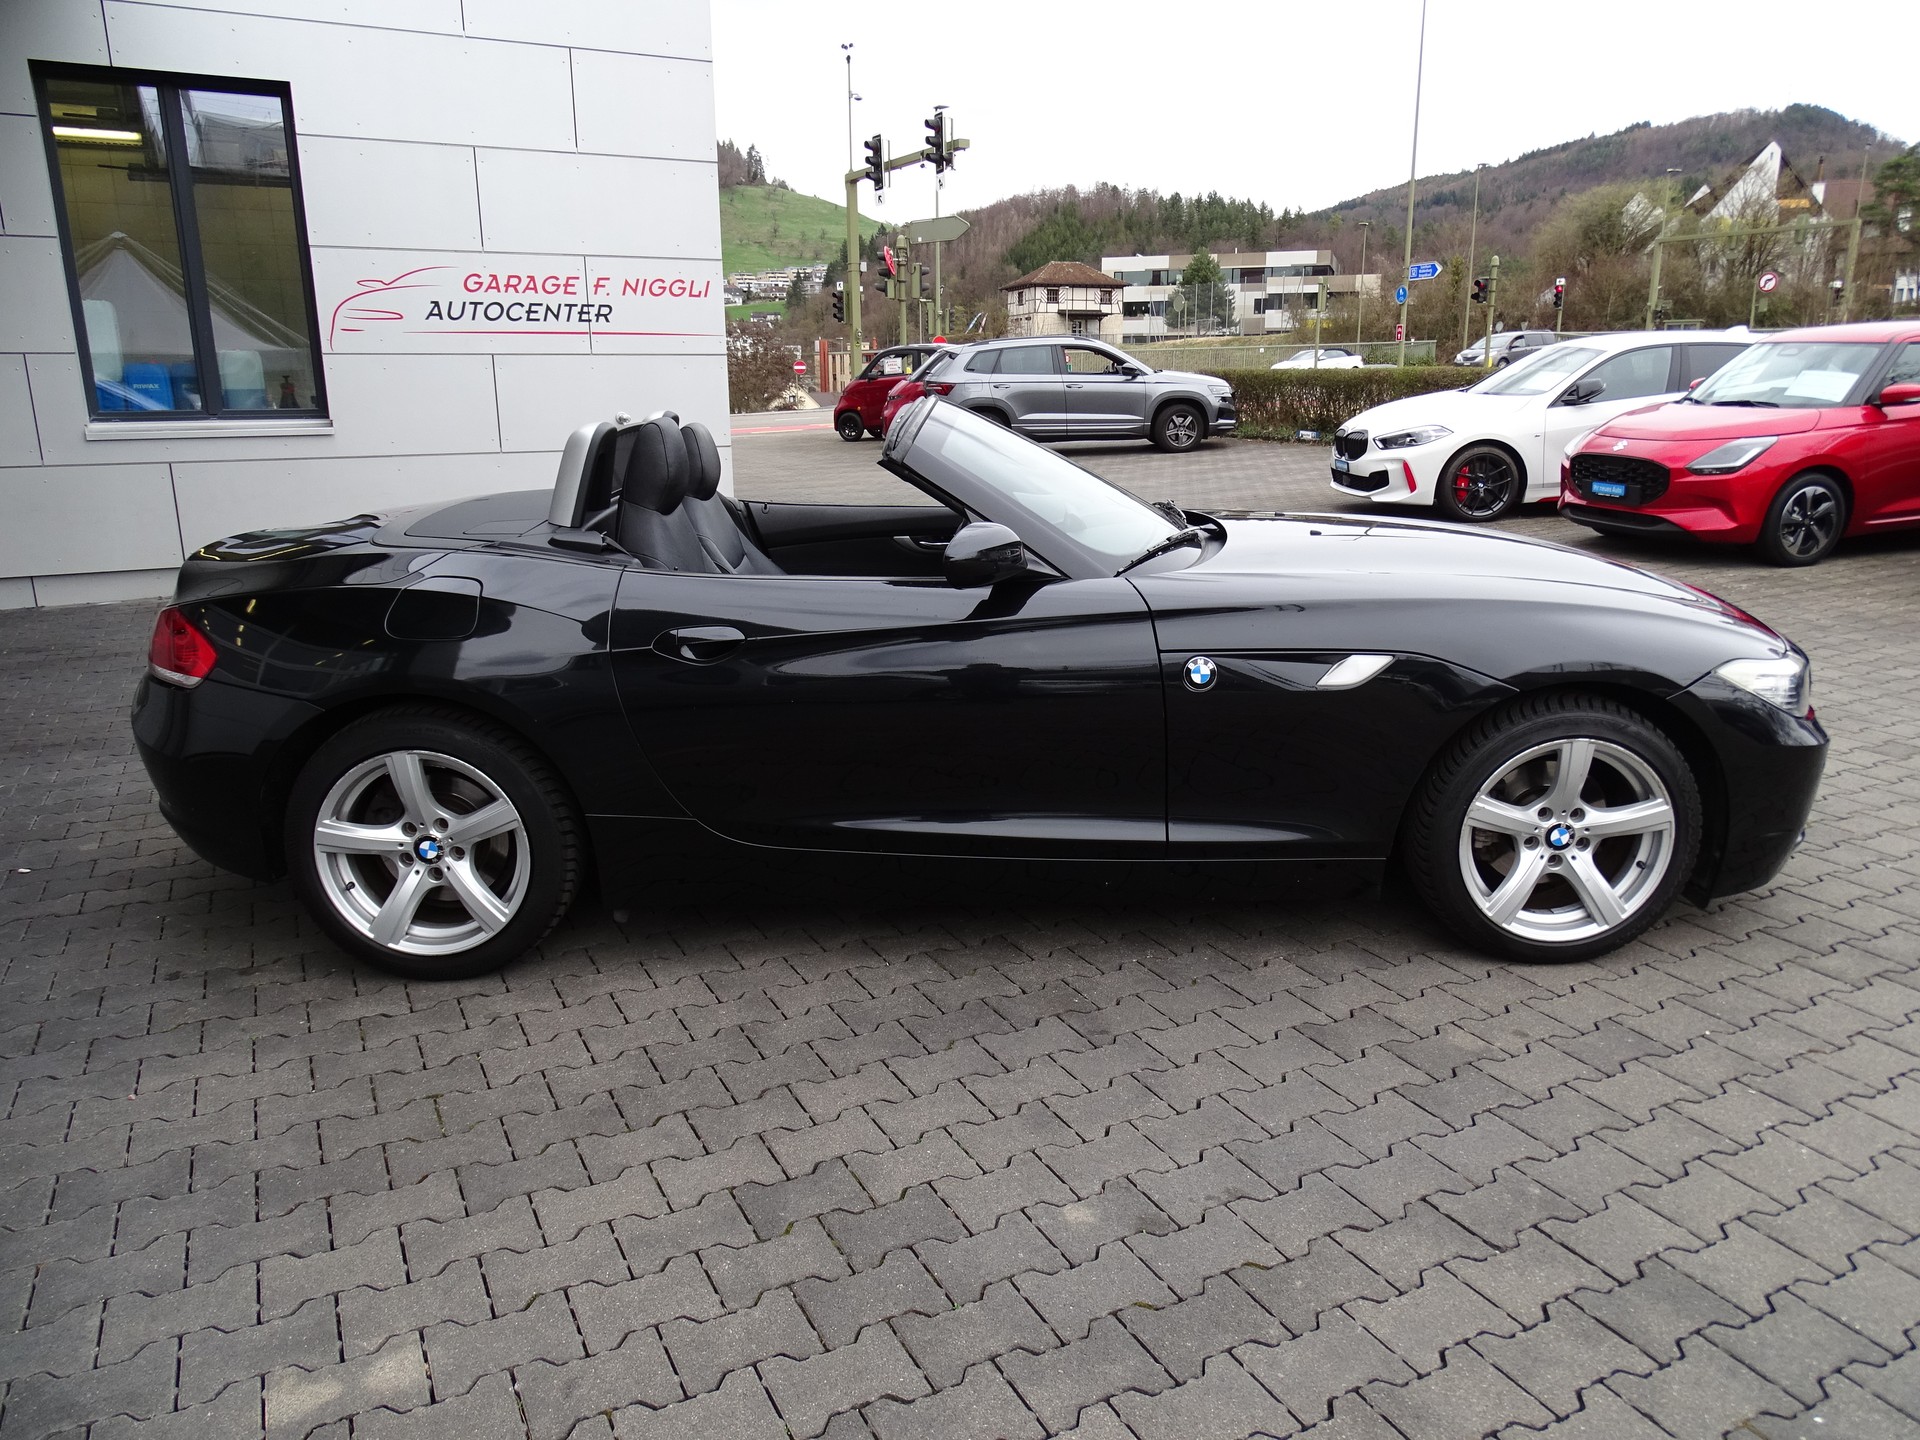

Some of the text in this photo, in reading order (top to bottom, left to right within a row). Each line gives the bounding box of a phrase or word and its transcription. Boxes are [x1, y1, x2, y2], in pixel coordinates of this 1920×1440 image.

[463, 273, 710, 298] GARAGE F. NIGGLI
[425, 300, 613, 323] AUTOCENTER
[1187, 658, 1215, 670] BMW
